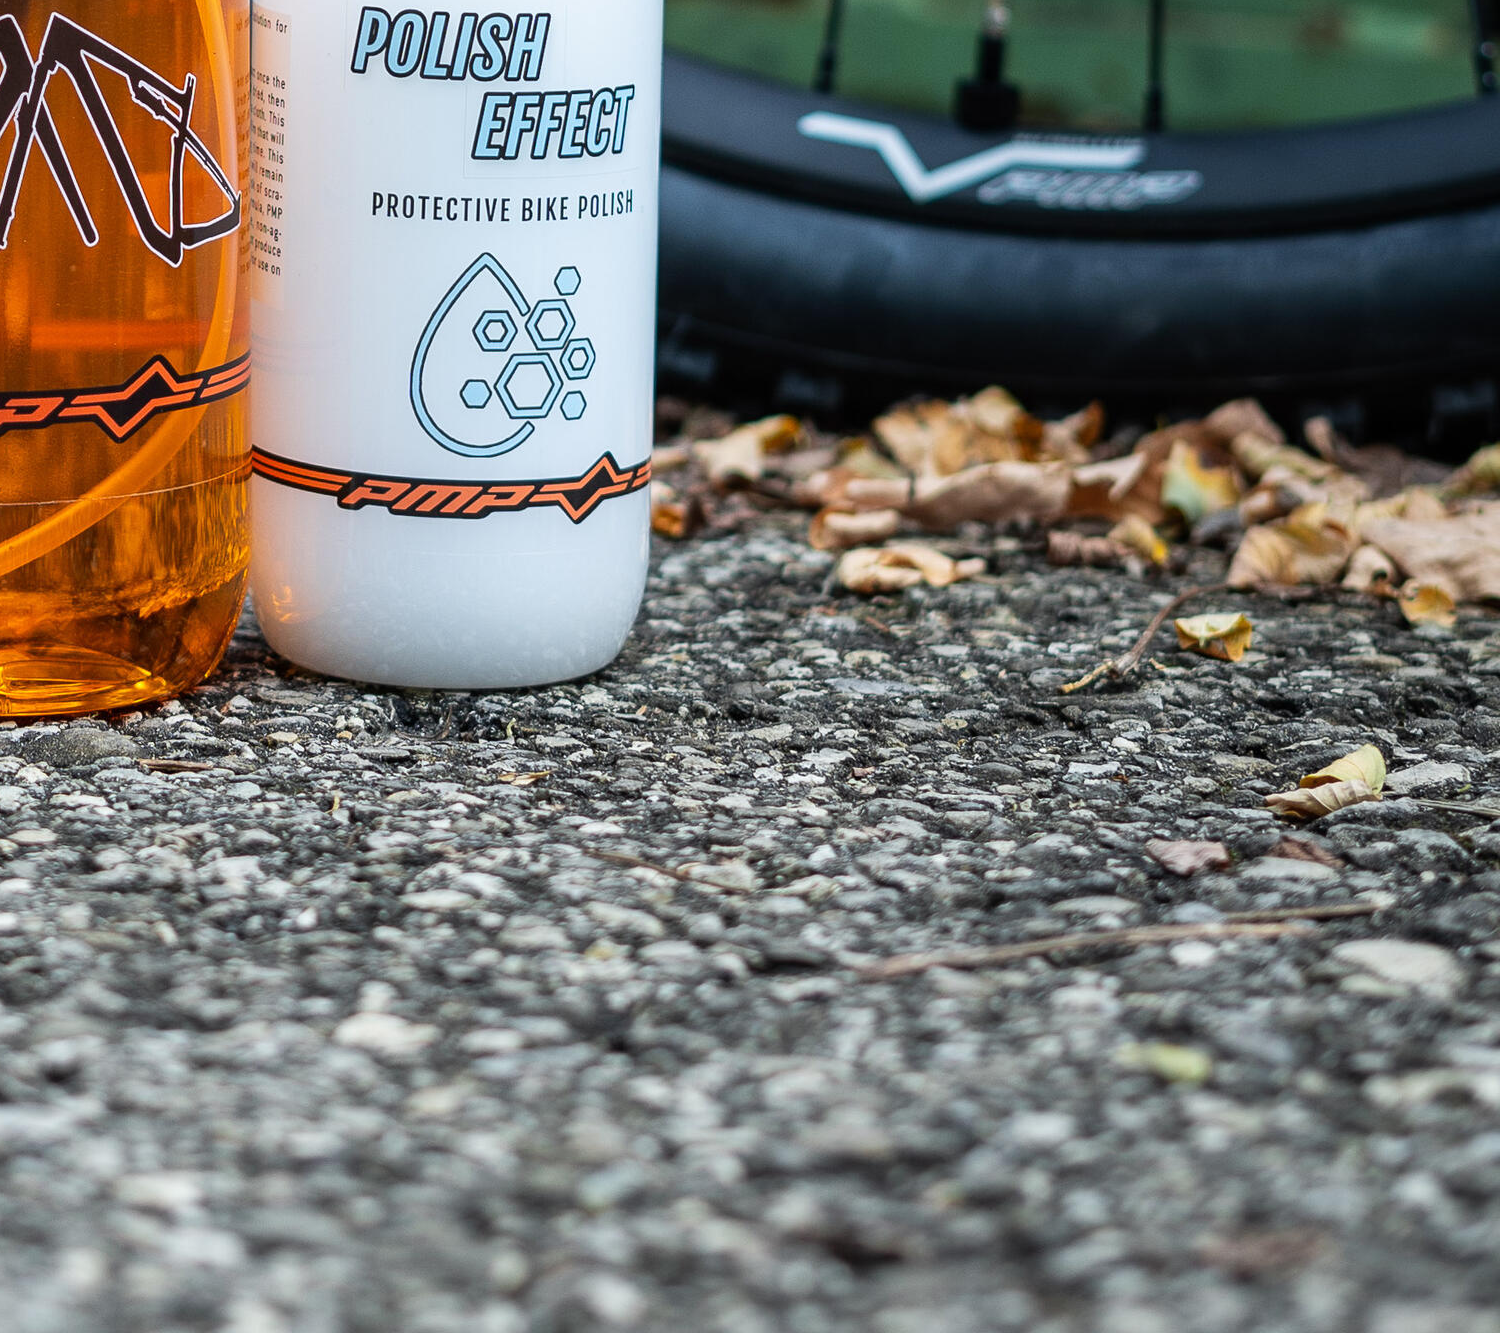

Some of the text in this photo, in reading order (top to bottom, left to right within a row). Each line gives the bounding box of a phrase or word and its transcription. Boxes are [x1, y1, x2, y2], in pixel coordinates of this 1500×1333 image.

[350, 6, 551, 81] POLISH
[272, 76, 286, 89] the
[268, 93, 285, 108] then
[269, 110, 285, 127] This
[471, 84, 635, 160] EFFECT
[270, 132, 285, 146] will
[268, 148, 284, 165] This
[259, 167, 283, 183] remain
[267, 203, 283, 219] PMP
[371, 189, 634, 222] PROTECTIVE BIKE POLISH
[270, 265, 281, 276] on
[341, 479, 535, 514] PMP
